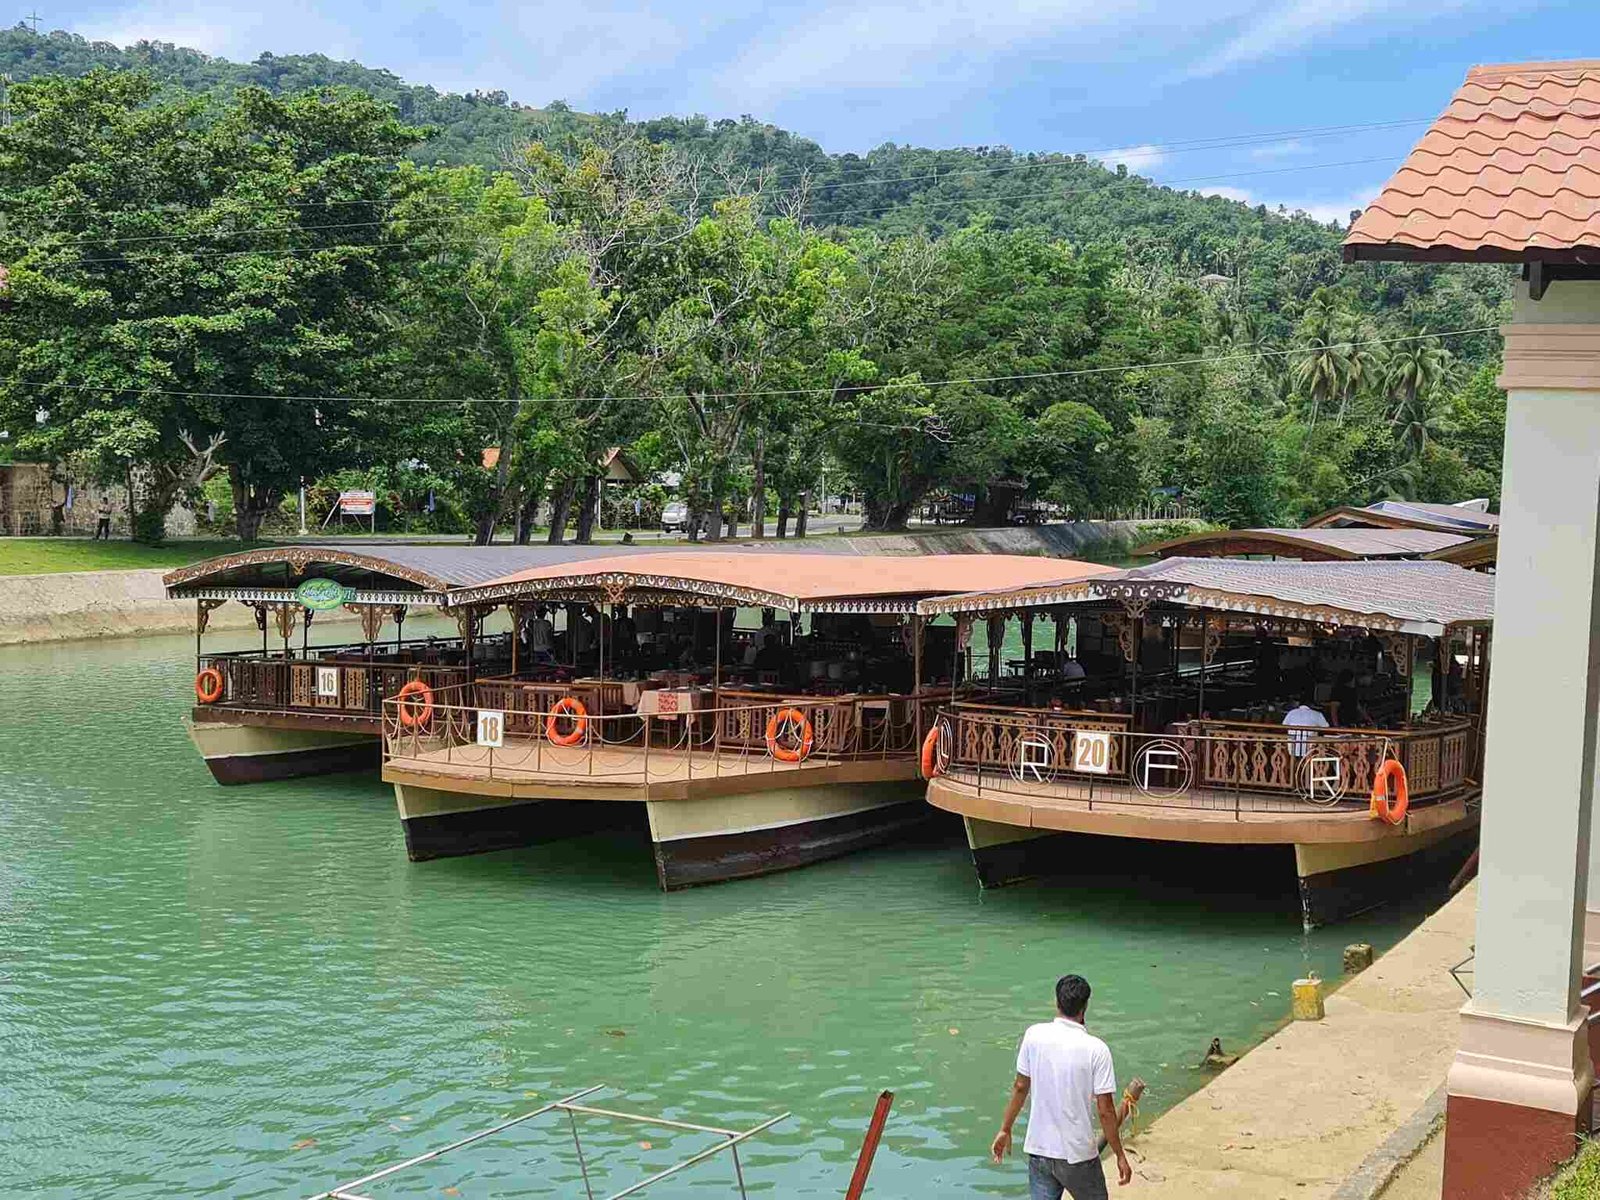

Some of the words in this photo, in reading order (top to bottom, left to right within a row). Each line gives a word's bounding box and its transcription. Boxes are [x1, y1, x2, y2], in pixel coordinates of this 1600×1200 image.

[321, 672, 334, 692] 16
[481, 716, 499, 742] 18
[1078, 738, 1105, 767] 20
[1020, 741, 1047, 782] R
[1144, 750, 1179, 790] F
[1310, 757, 1340, 799] R
